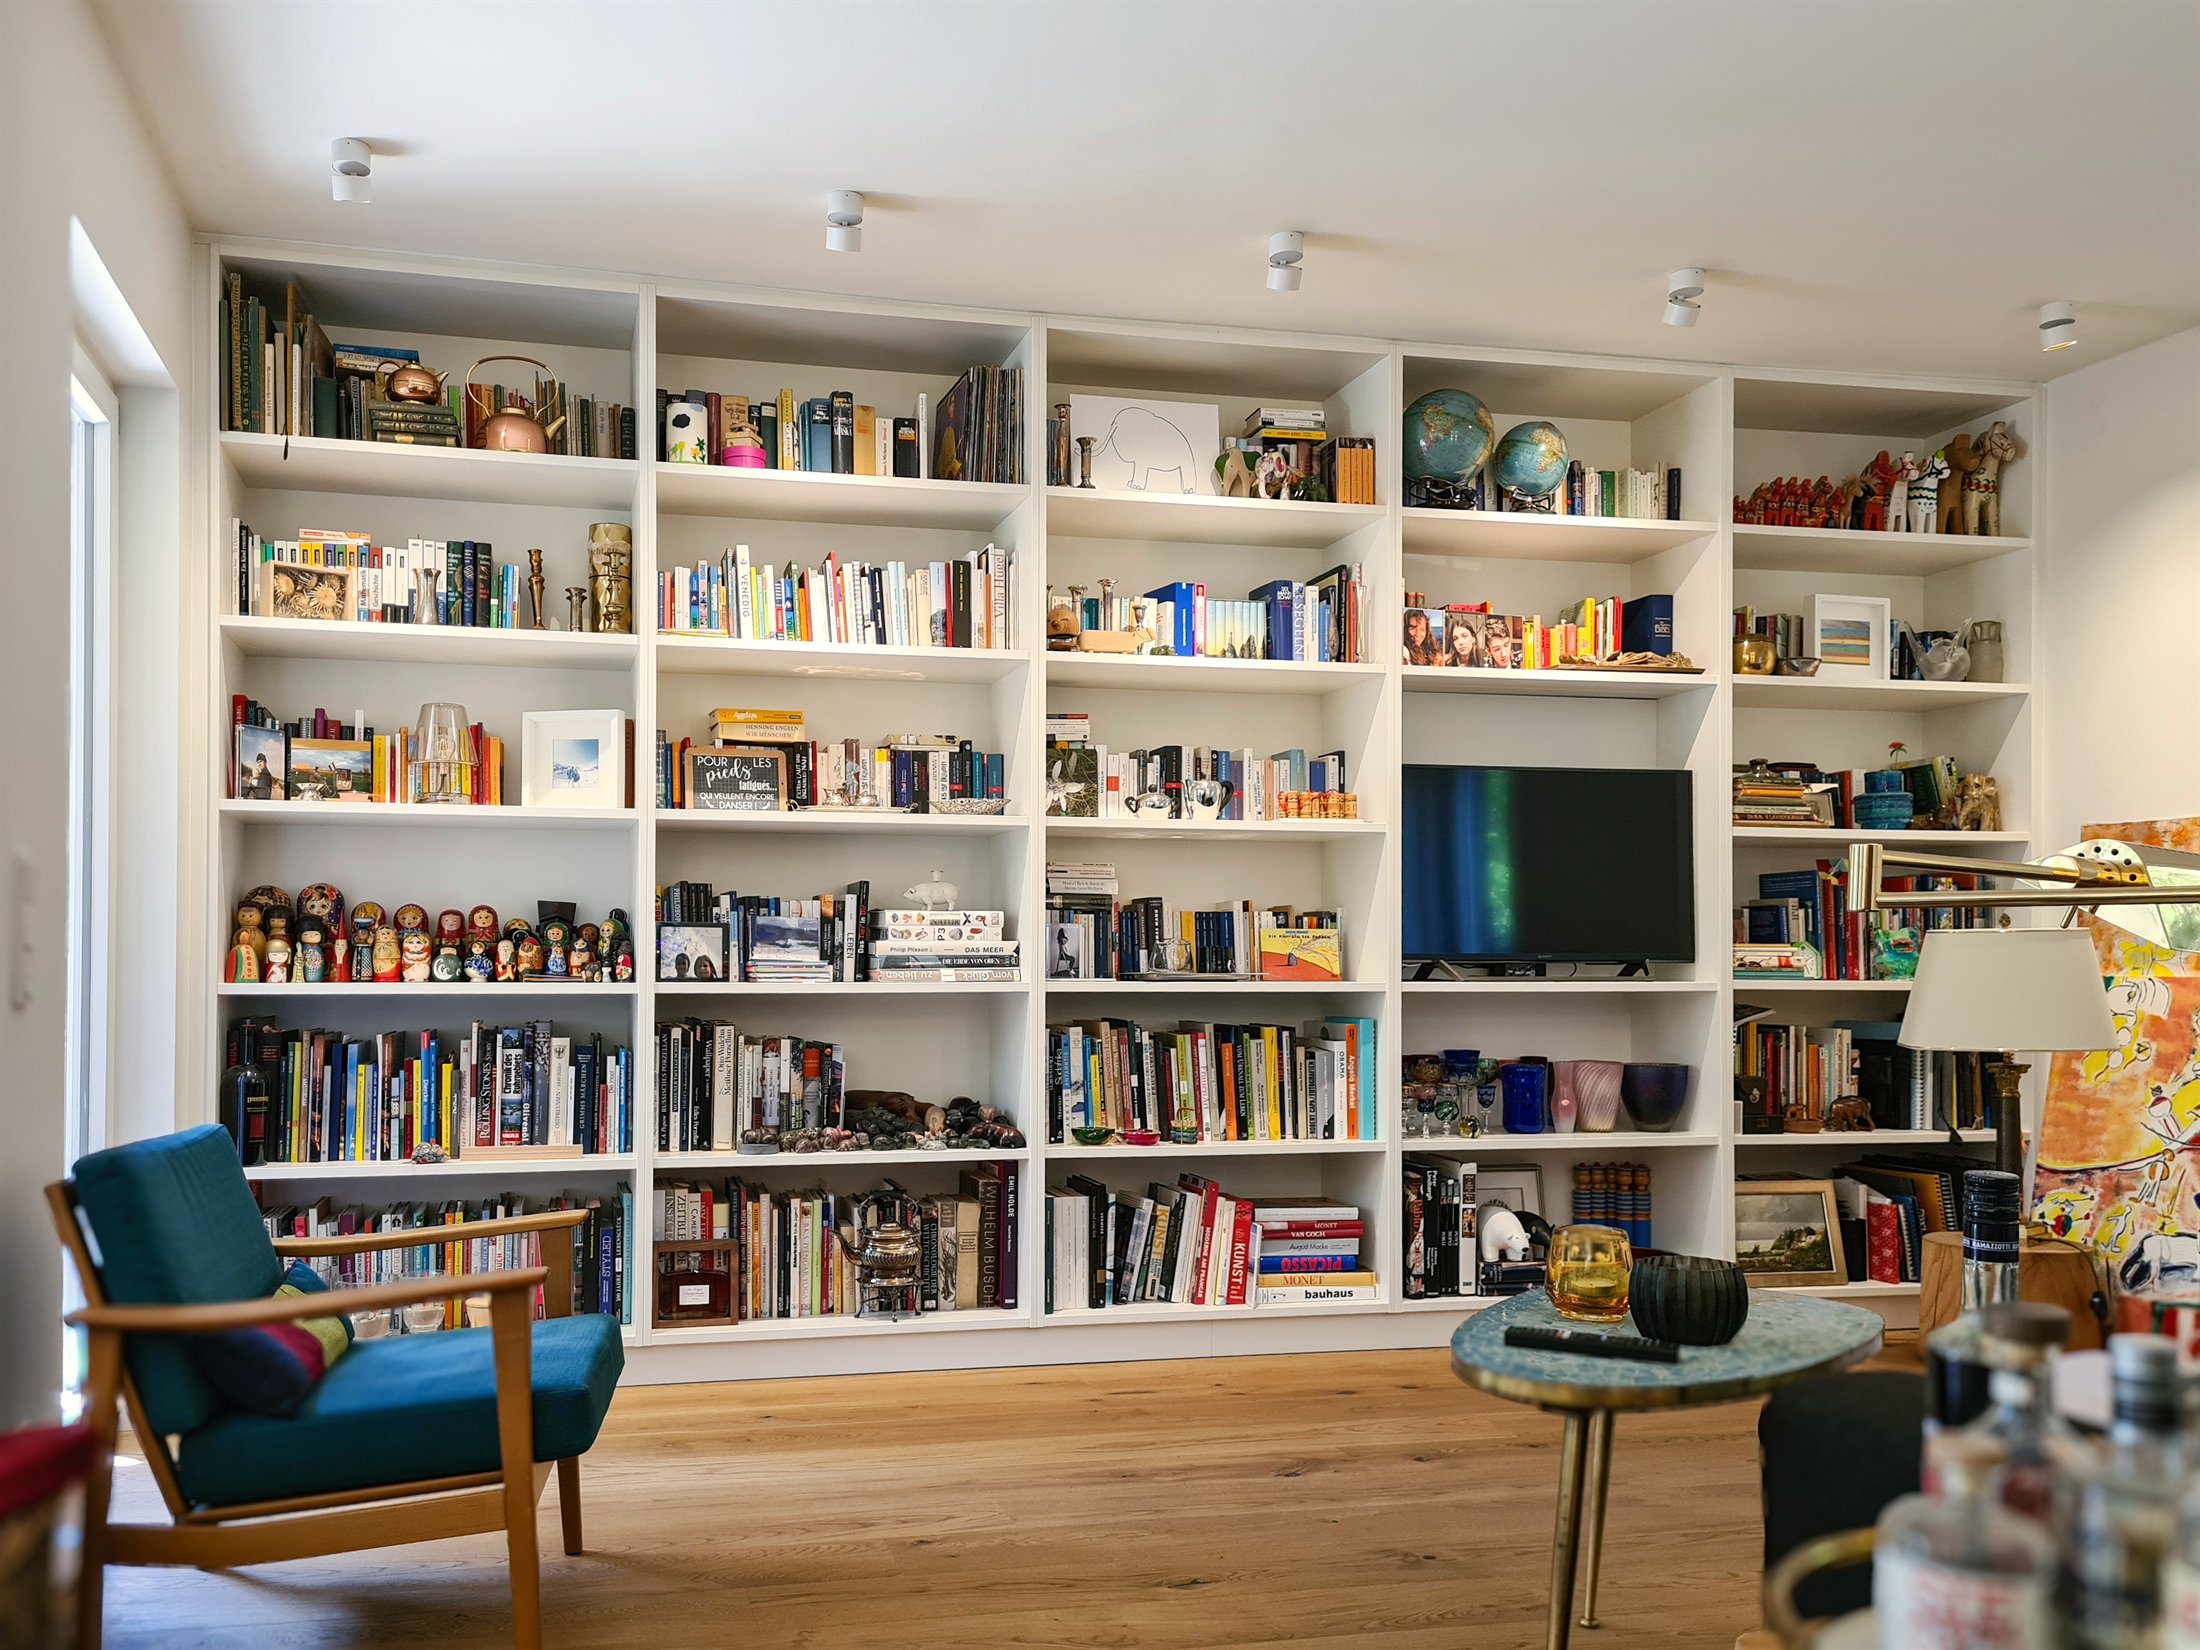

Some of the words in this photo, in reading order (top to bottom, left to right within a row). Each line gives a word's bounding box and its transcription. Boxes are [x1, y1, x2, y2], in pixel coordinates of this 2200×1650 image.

[993, 554, 1007, 589] Hügel
[740, 573, 750, 618] VENEDIG
[994, 592, 1005, 618] Villa
[1293, 602, 1305, 654] SEGELN
[745, 723, 774, 731] HENNING
[775, 724, 800, 732] ENGELN
[697, 755, 728, 767] POUR
[753, 757, 772, 768] LES
[706, 757, 752, 789] pieds
[699, 791, 713, 801] QUI
[714, 792, 744, 801] VEULENT
[745, 793, 775, 801] ENCORE
[719, 800, 753, 809] DANSER
[845, 932, 854, 958] LEBEN
[953, 957, 970, 965] ERDE
[659, 1033, 669, 1072] PORZELLAN
[704, 1039, 713, 1078] Wallpaper
[717, 1028, 726, 1056] Walcha
[724, 1028, 733, 1065] Porzellan
[480, 1062, 492, 1097] STONES
[502, 1067, 513, 1095] Chronik
[513, 1053, 524, 1095] Ruhrgebiets
[577, 1063, 587, 1100] MÄRCHEN
[724, 1065, 732, 1095] Meißner
[1052, 1048, 1063, 1086] Südafrika
[1062, 1051, 1070, 1087] ANTARKTIS
[1306, 1061, 1315, 1096] FOTOGRAFIEN
[660, 1072, 668, 1113] RUSSISCHES
[1063, 1092, 1071, 1128] ARKTIS
[480, 1098, 491, 1139] ROLLING
[578, 1100, 586, 1130] GRIMMS
[1425, 1170, 1433, 1201] Lindbergh
[739, 1209, 747, 1245] Bibel-Atlas
[982, 1184, 998, 1249] WILHELM
[1152, 1208, 1169, 1259] KUNST
[601, 1235, 611, 1277] STYLED
[922, 1222, 931, 1294] WELTGESCHICHTE
[930, 1222, 938, 1277] CHRONOLOGIE
[1231, 1242, 1246, 1284] KUNST
[1288, 1242, 1310, 1253] August
[1972, 1240, 2012, 1251] RAMAZZOTTI
[982, 1255, 996, 1303] BUSCH
[1280, 1256, 1343, 1272] PICASSO
[1282, 1275, 1325, 1286] MONET
[1304, 1289, 1354, 1300] bauhaus
